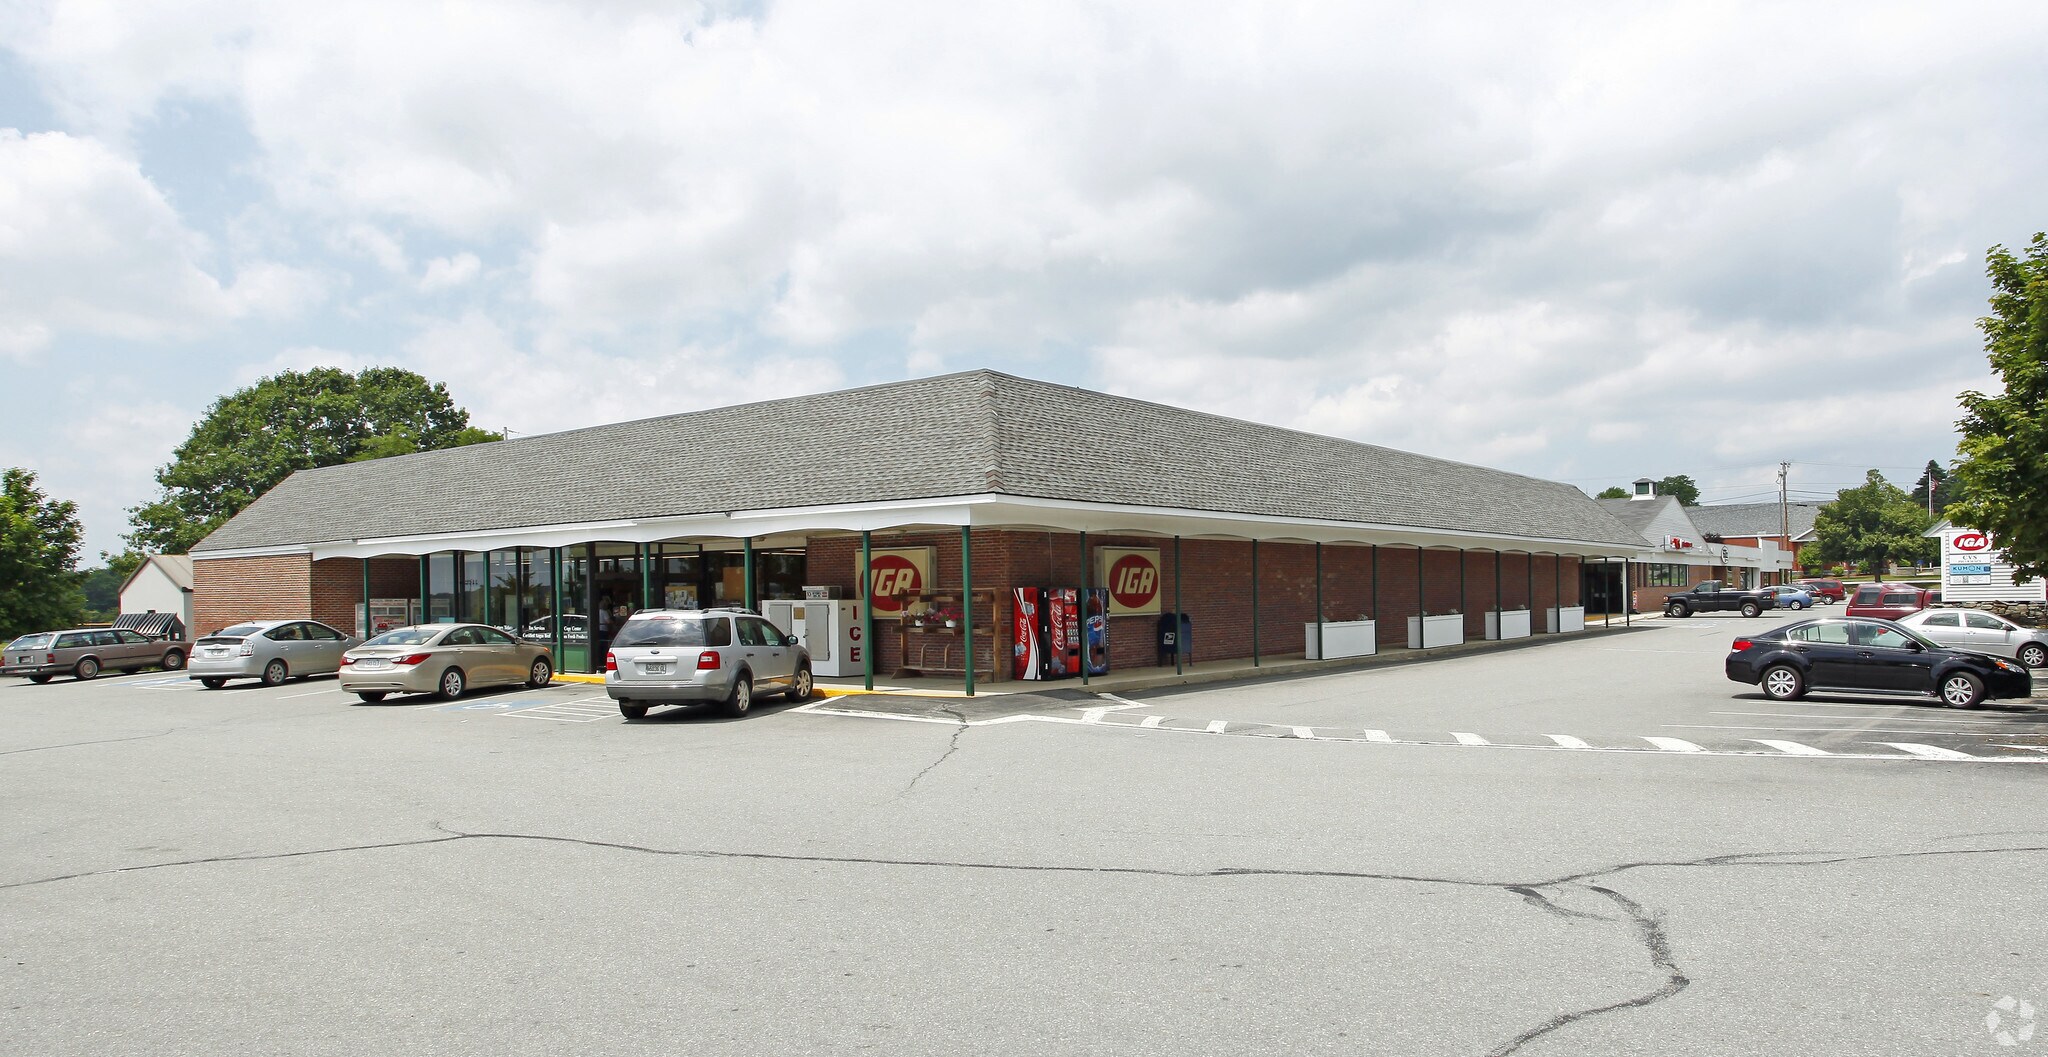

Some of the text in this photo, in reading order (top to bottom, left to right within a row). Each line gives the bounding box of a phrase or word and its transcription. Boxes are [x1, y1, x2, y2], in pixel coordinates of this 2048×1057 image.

[1957, 537, 1985, 548] IGA
[1116, 567, 1155, 594] IGA
[1086, 615, 1103, 625] PEPS
[849, 605, 862, 662] ICE
